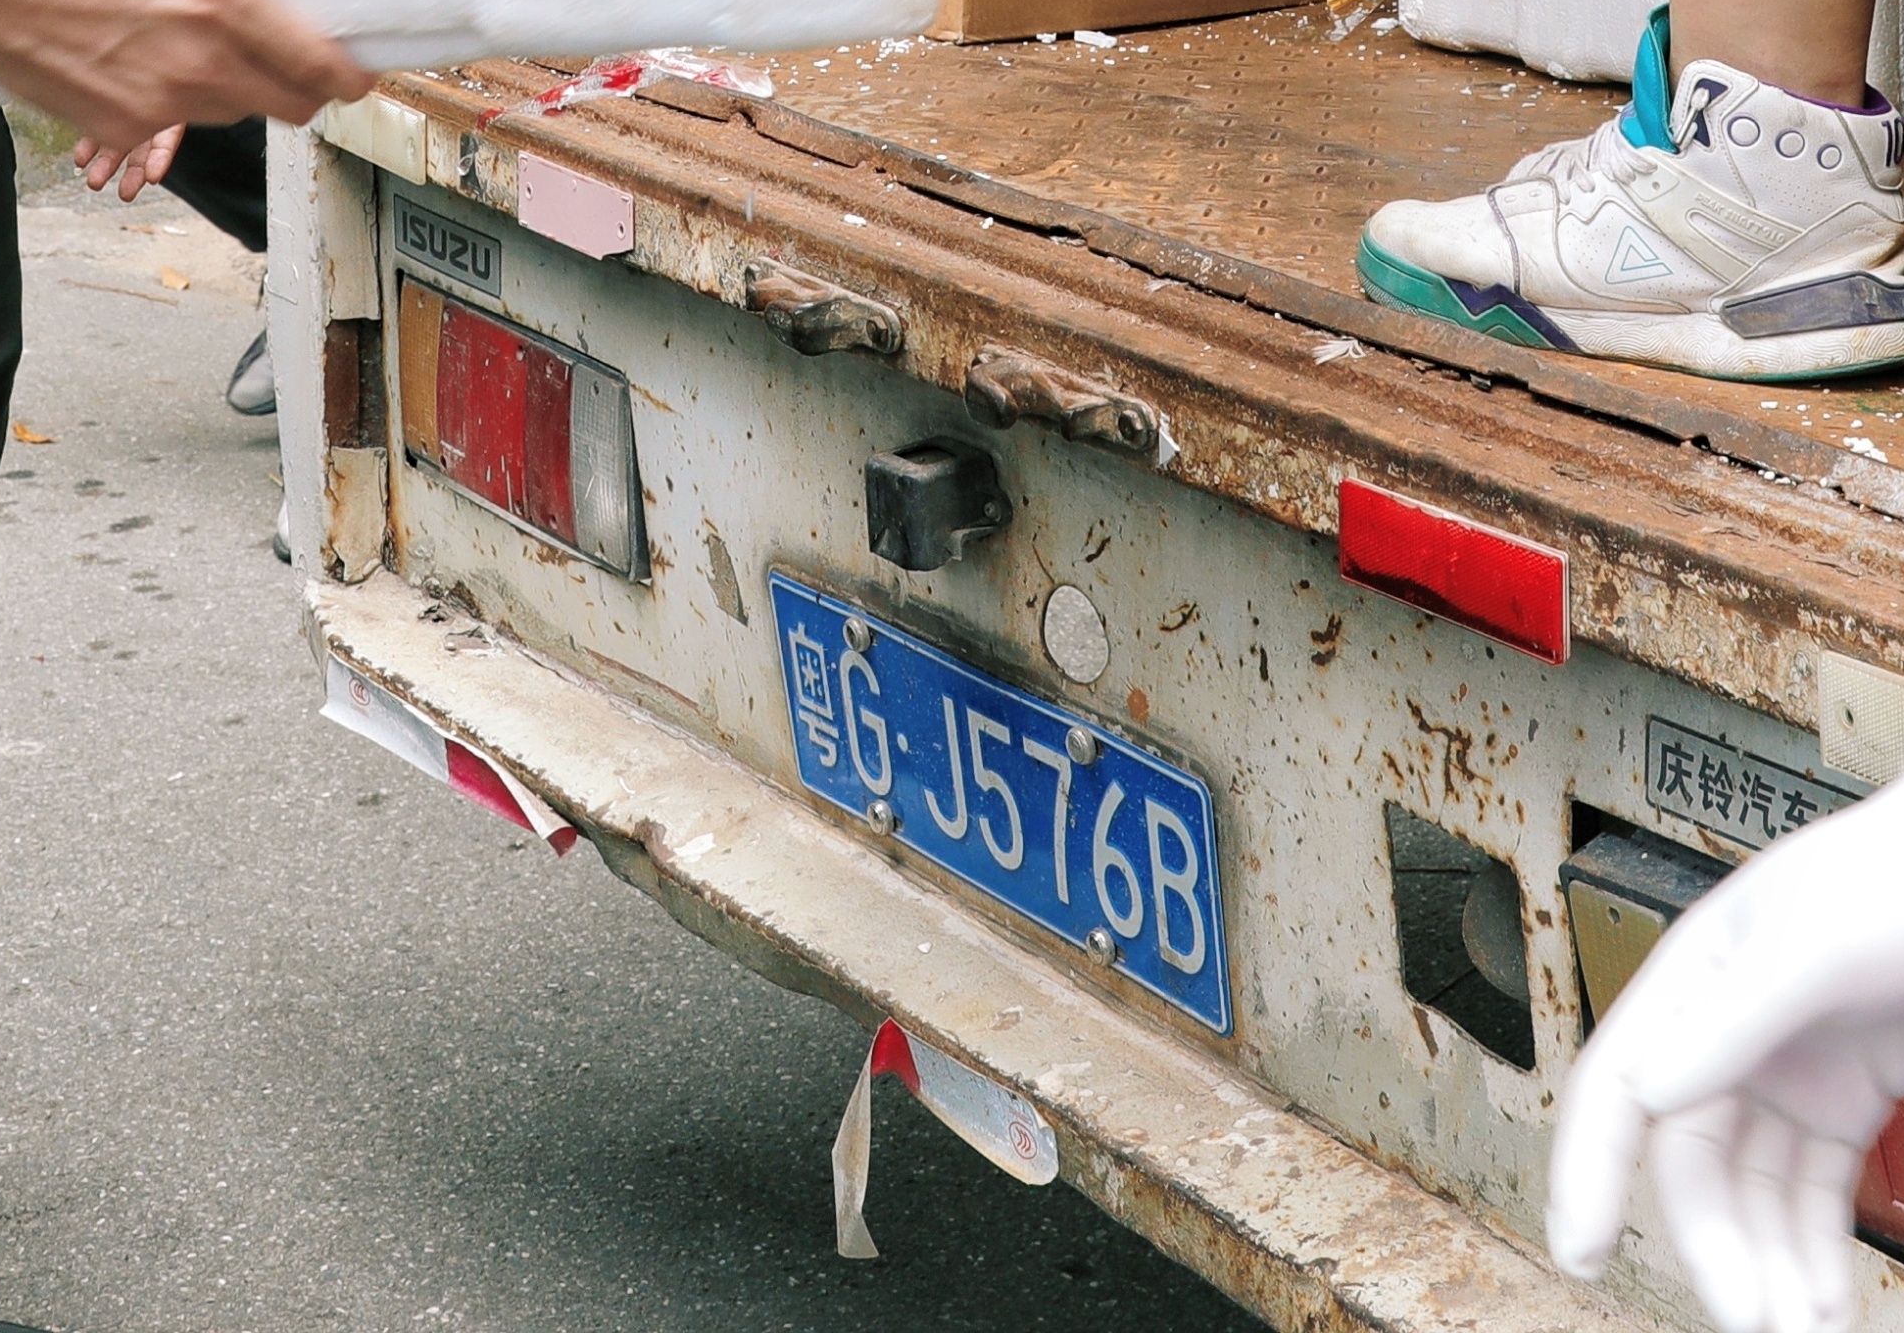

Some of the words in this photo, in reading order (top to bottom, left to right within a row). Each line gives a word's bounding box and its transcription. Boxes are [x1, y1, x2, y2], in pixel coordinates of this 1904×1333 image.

[402, 210, 491, 281] ISUZU
[1656, 741, 1818, 840] 庆铃汽车
